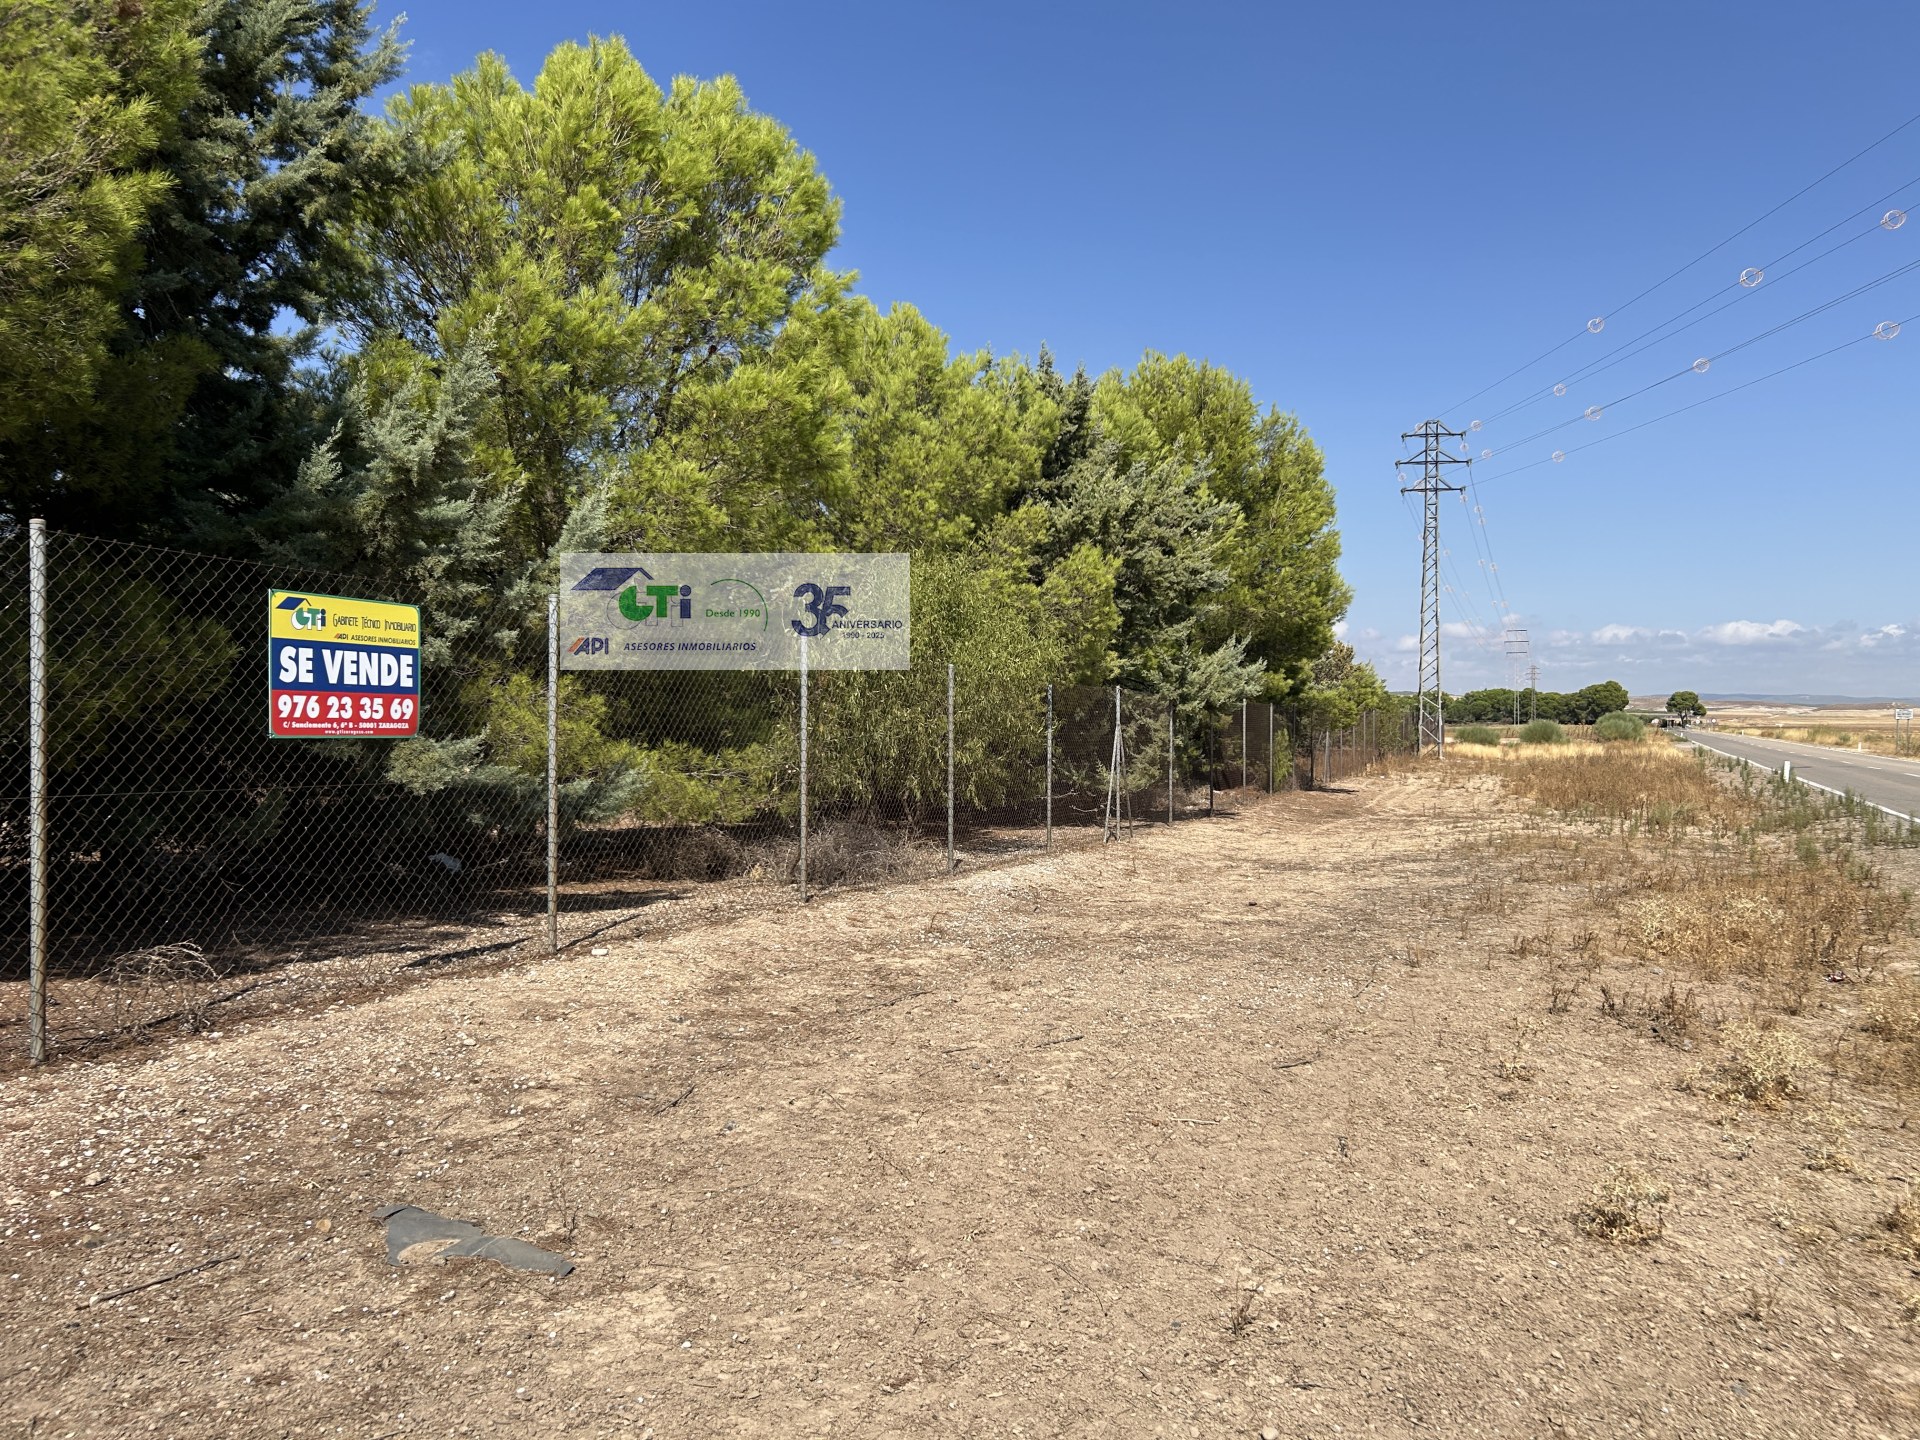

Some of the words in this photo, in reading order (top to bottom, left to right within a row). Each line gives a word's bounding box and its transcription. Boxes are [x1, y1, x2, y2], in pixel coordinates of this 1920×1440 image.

[351, 635, 377, 643] ASESORES
[378, 636, 416, 646] INMOBILIARIOS
[279, 645, 314, 684] SE
[321, 648, 414, 688] VENDE
[278, 694, 320, 719] 976
[326, 695, 353, 720] 23
[359, 696, 384, 720] 35
[390, 698, 414, 720] 69
[283, 721, 291, 729] C/
